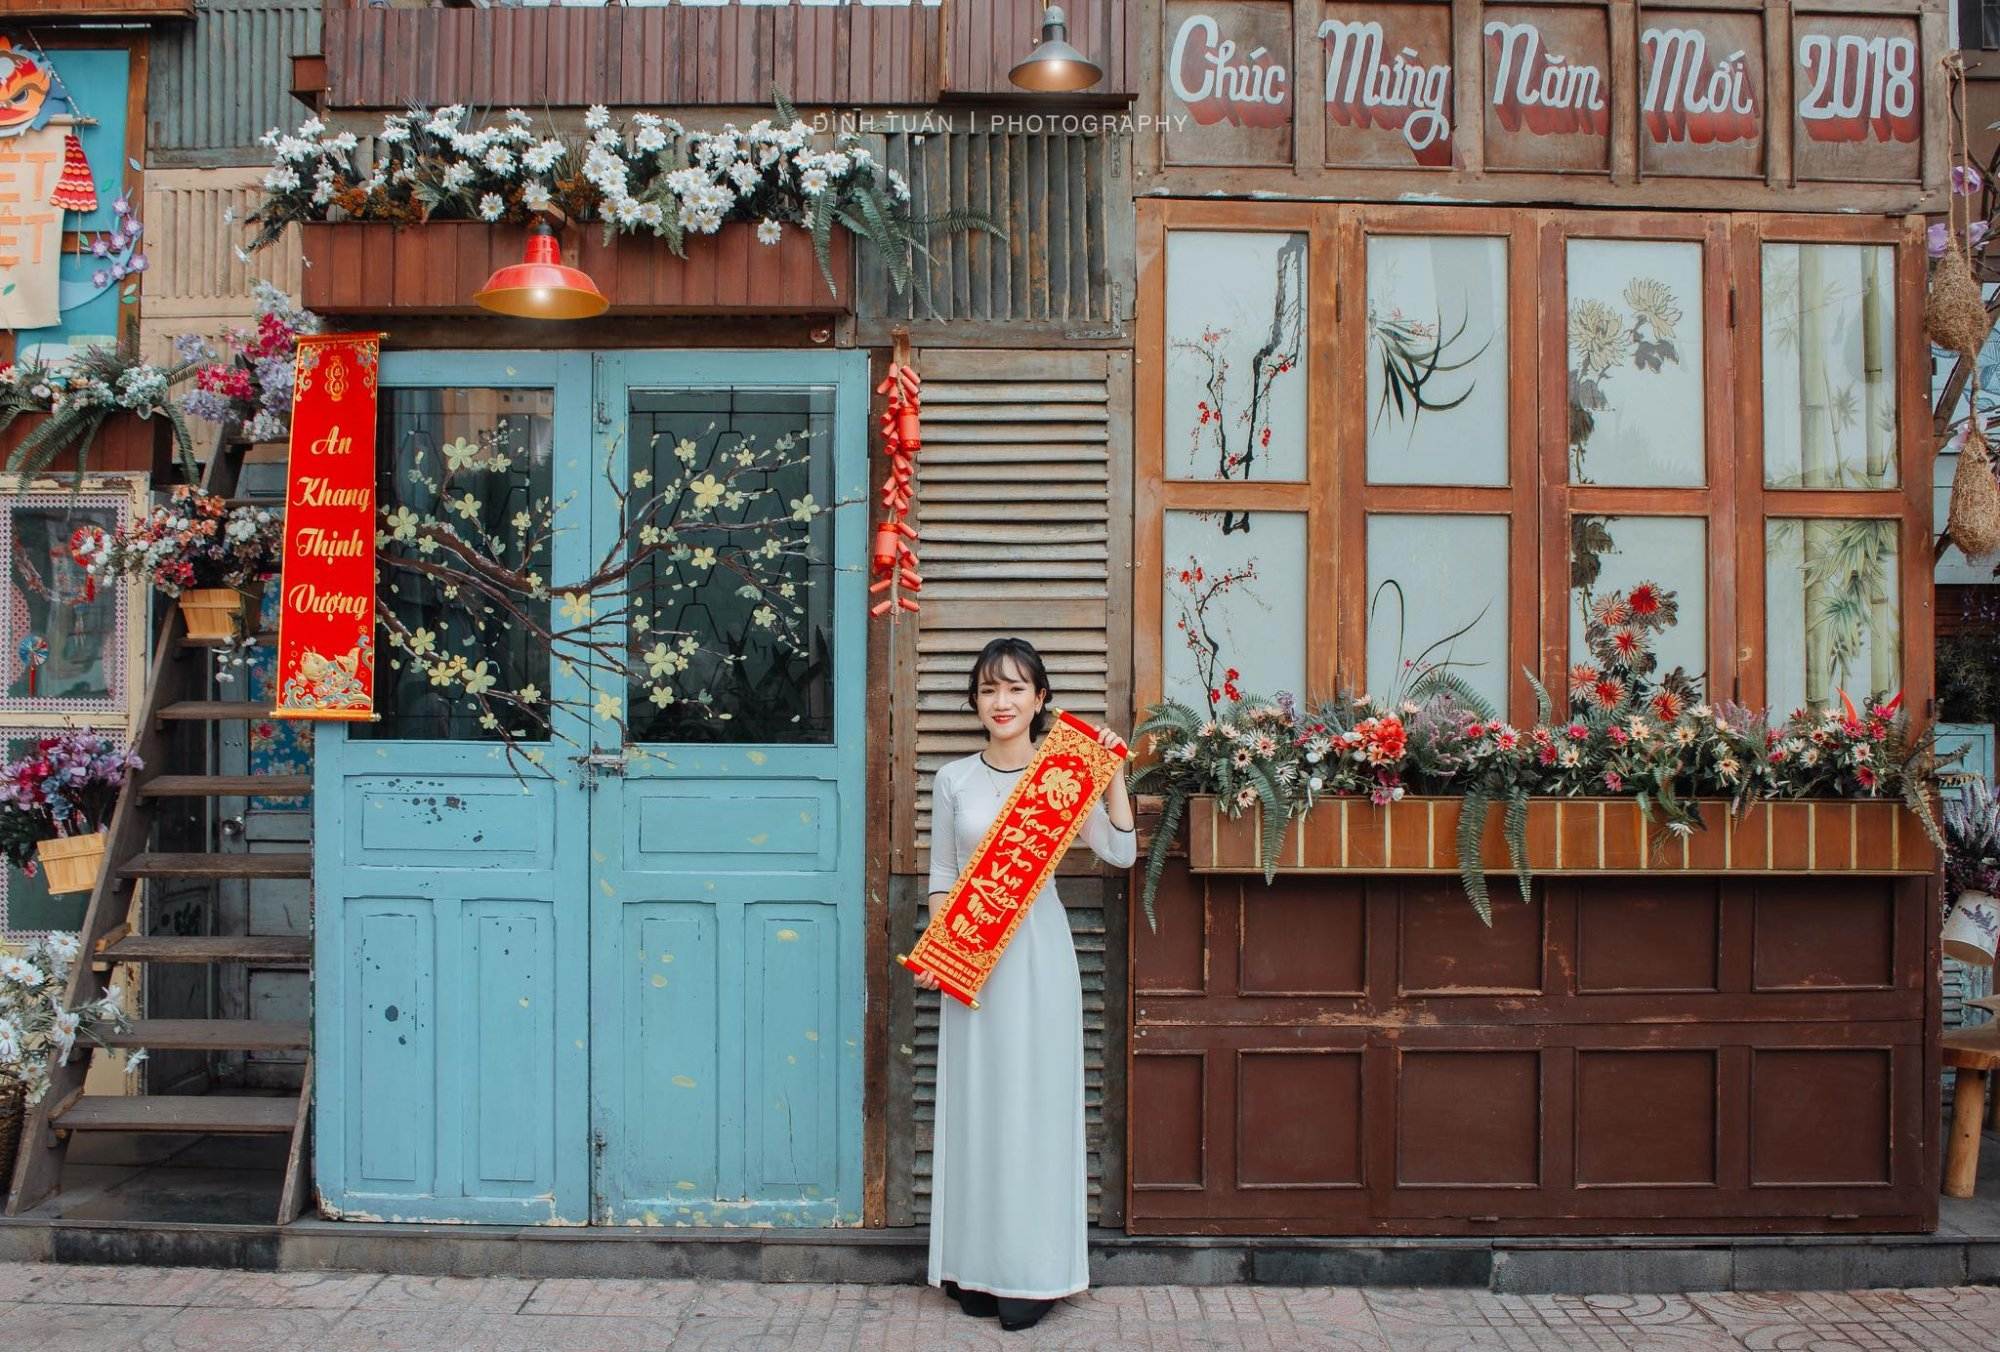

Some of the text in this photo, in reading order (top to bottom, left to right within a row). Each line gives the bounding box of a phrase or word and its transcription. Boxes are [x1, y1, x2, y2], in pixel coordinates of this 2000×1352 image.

[1170, 14, 1915, 151] Chúc Mừng Năm Mới 2018
[310, 424, 352, 455] An
[292, 476, 371, 513] Khang
[295, 526, 364, 565] Thịnh
[288, 583, 368, 622] Vượng
[1014, 805, 1066, 842] Hạnh
[995, 846, 1033, 873] An
[998, 824, 1049, 861] Phúc
[990, 860, 1023, 891] Vui
